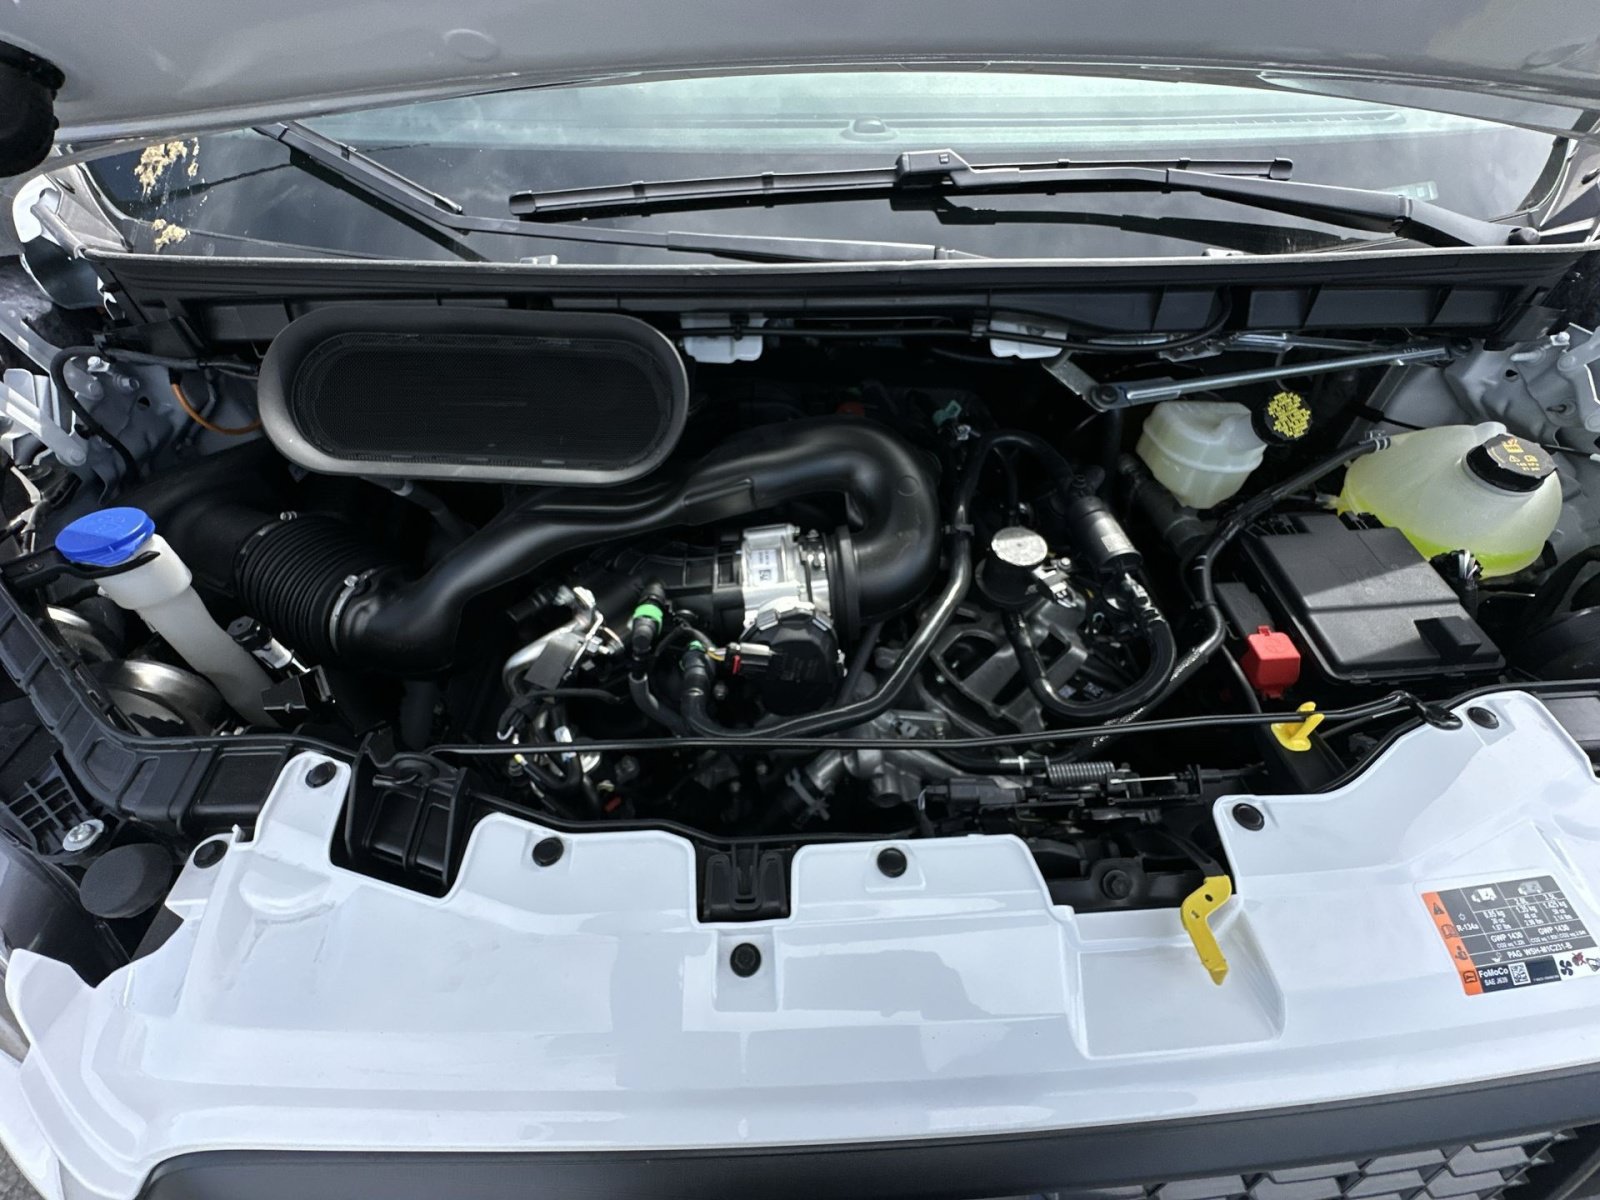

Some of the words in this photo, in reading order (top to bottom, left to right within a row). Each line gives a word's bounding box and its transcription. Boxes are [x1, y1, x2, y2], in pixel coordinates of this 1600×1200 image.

[1557, 900, 1568, 908] kg
[1528, 905, 1538, 913] kg
[1496, 910, 1506, 918] kg
[1456, 923, 1479, 932] R-134a
[1538, 927, 1553, 935] GWP
[1554, 924, 1570, 932] 1430
[1491, 934, 1506, 943] GWP
[1508, 932, 1523, 940] 1430
[1507, 950, 1523, 959] PAG
[1524, 942, 1573, 955] WSH-M1C231-B
[1478, 968, 1509, 978] FoMoCo
